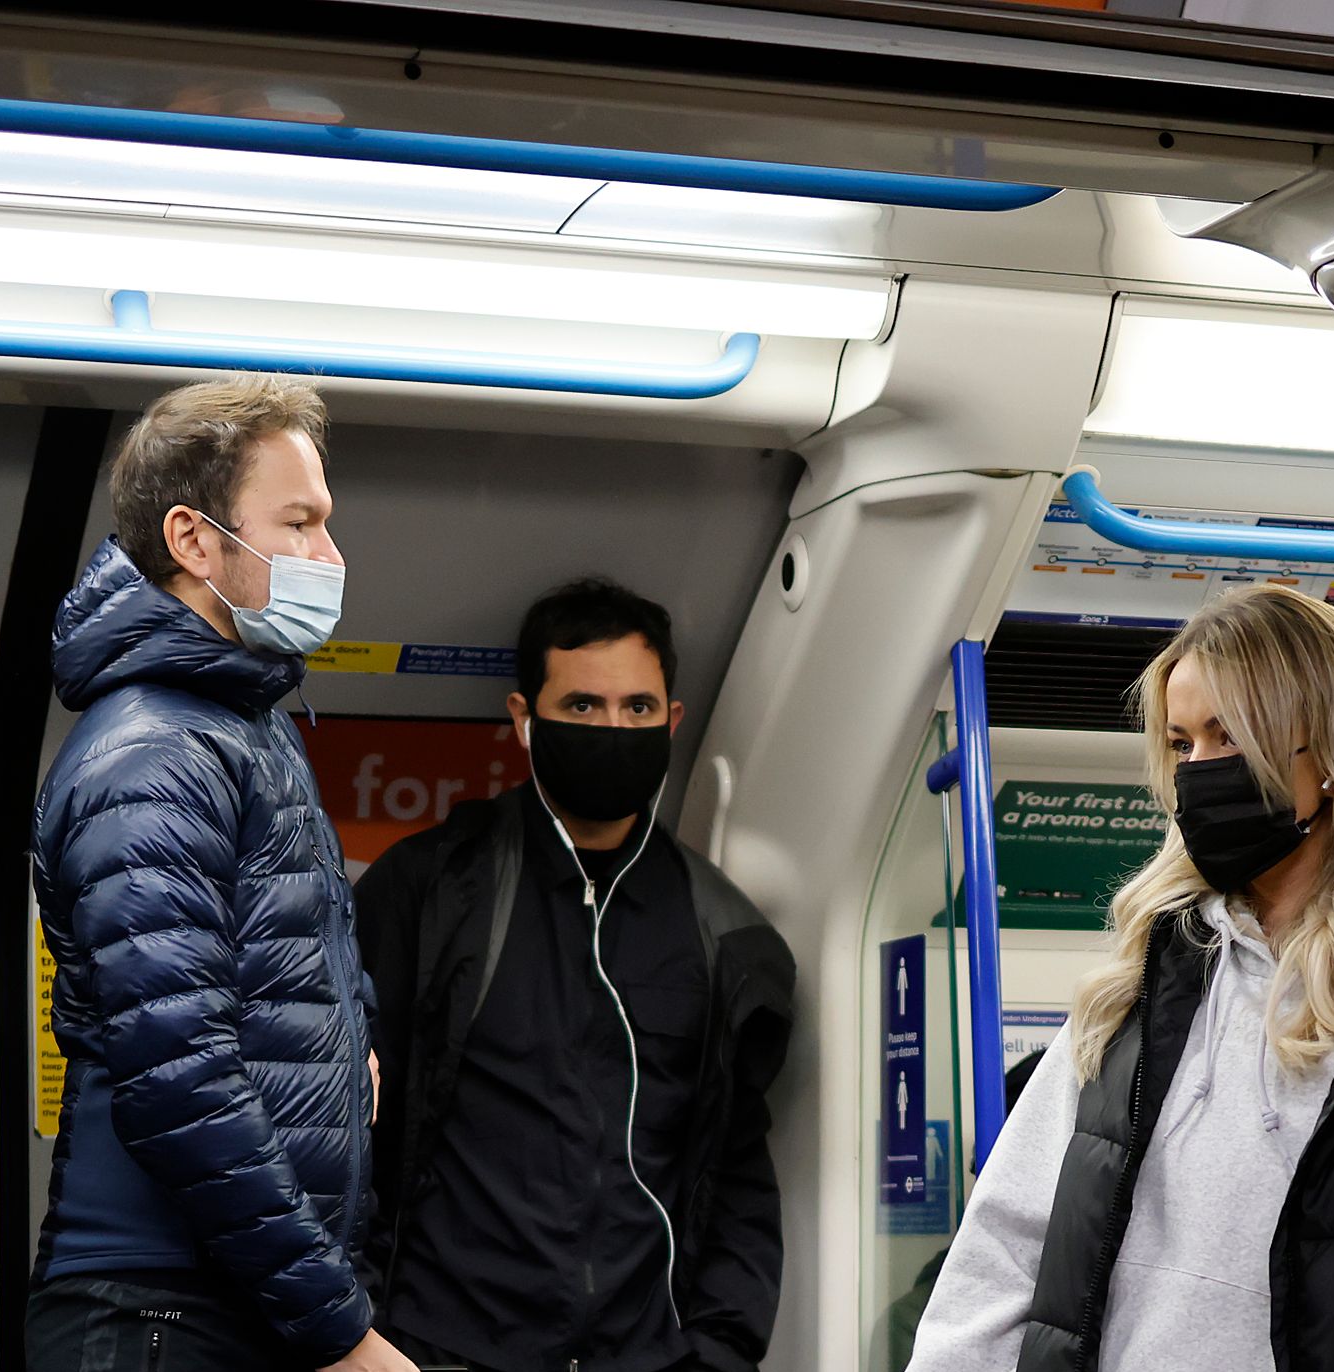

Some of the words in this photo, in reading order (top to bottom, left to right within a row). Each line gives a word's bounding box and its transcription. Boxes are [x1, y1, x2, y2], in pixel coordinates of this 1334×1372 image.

[1078, 613, 1102, 623] Zone
[410, 647, 455, 658] Penalty
[351, 753, 465, 821] for
[1016, 790, 1070, 808] Your
[1074, 793, 1126, 810] first
[1003, 812, 1020, 824] a
[1022, 812, 1104, 828] promo
[1109, 815, 1167, 830] code
[1023, 1014, 1066, 1024] Underground
[888, 1033, 904, 1044] Please
[905, 1031, 918, 1043] keep
[898, 1046, 919, 1058] distance
[1003, 1039, 1024, 1053] ell
